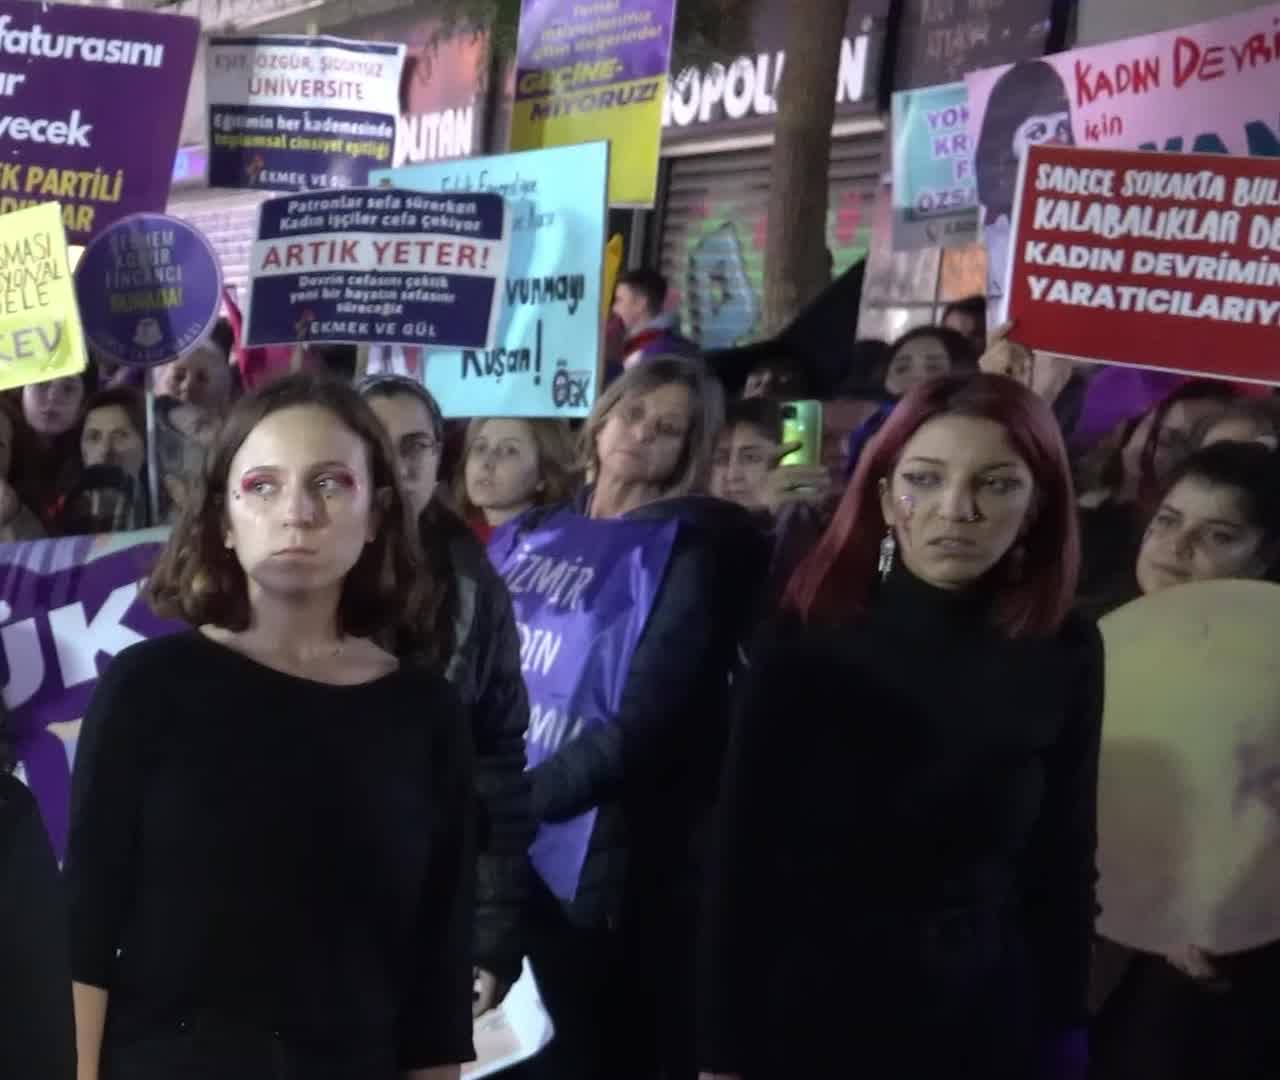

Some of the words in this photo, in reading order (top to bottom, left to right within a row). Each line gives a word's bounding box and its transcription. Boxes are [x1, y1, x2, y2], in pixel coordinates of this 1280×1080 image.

[1074, 56, 1160, 108] KADIN
[1085, 113, 1124, 142] için
[25, 164, 124, 202] PARTİLİ
[1035, 163, 1116, 198] SADECE
[1121, 169, 1227, 203] SOKAKTA
[1032, 197, 1240, 245] KALABALIKLAR
[261, 239, 360, 271] ARTIK
[372, 240, 490, 269] YETER!
[1024, 240, 1126, 273] KADIN
[1026, 275, 1280, 327] YARATICILARIY
[310, 320, 370, 337] EKMEK
[375, 320, 396, 336] VE
[402, 319, 438, 338] GÜL
